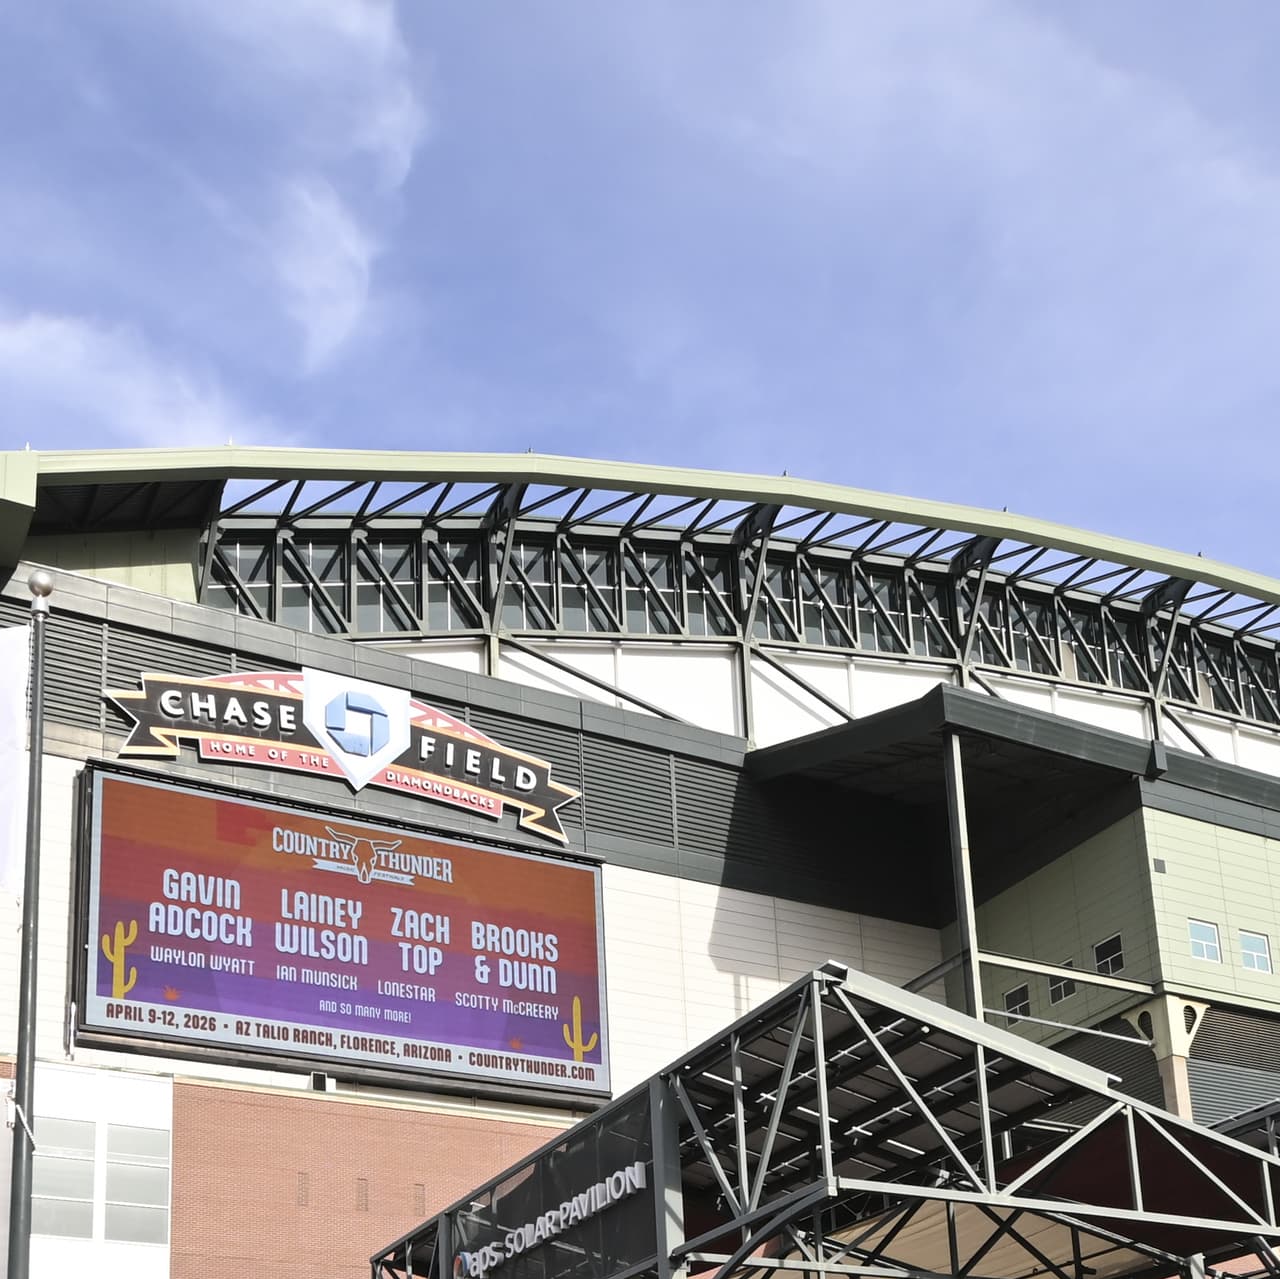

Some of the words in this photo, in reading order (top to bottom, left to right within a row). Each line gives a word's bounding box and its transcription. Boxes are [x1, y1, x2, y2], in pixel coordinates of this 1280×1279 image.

[159, 689, 297, 732] CHASE
[210, 741, 256, 757] HOME
[268, 748, 288, 761] OF
[300, 753, 329, 768] THE
[419, 735, 538, 791] FIELD
[385, 770, 495, 809] DIAMONDBACKS
[272, 827, 352, 860] COUNTRY
[377, 850, 454, 883] THUNDER
[163, 868, 241, 910] GAVIN
[281, 888, 362, 929] LAINEY
[149, 902, 253, 947] ADCOCK
[275, 923, 368, 966] WILSON
[390, 907, 450, 945] ZACH
[471, 921, 559, 962] BROOKS
[150, 945, 205, 969] WAYLON
[210, 955, 256, 976] WYATT
[276, 964, 297, 982] IAN
[301, 968, 358, 991] MUNSICK
[399, 942, 443, 976] TOP
[475, 955, 491, 984] &
[499, 958, 557, 995] DUNN
[377, 980, 436, 1003] LONESTAR
[455, 992, 499, 1011] SCOTTY
[502, 999, 560, 1021] McCREERY
[319, 1000, 337, 1013] AND
[340, 1002, 353, 1015] SO
[355, 1004, 381, 1020] MANY
[383, 1009, 412, 1024] MORE!
[106, 1003, 144, 1023] APRIL
[148, 1009, 179, 1029] 9-12,
[183, 1013, 217, 1032] 2026
[235, 1020, 251, 1037] AZ
[255, 1022, 290, 1042] TALIO
[293, 1027, 338, 1050] RANCH,
[340, 1034, 401, 1058] FLORENCE,
[403, 1043, 452, 1063] ARIZONA
[469, 1051, 596, 1082] COUNTRYTHUNDER.COM
[470, 1241, 505, 1279] aps
[505, 1210, 561, 1258] SOLAR
[559, 1161, 647, 1230] PAVILION
